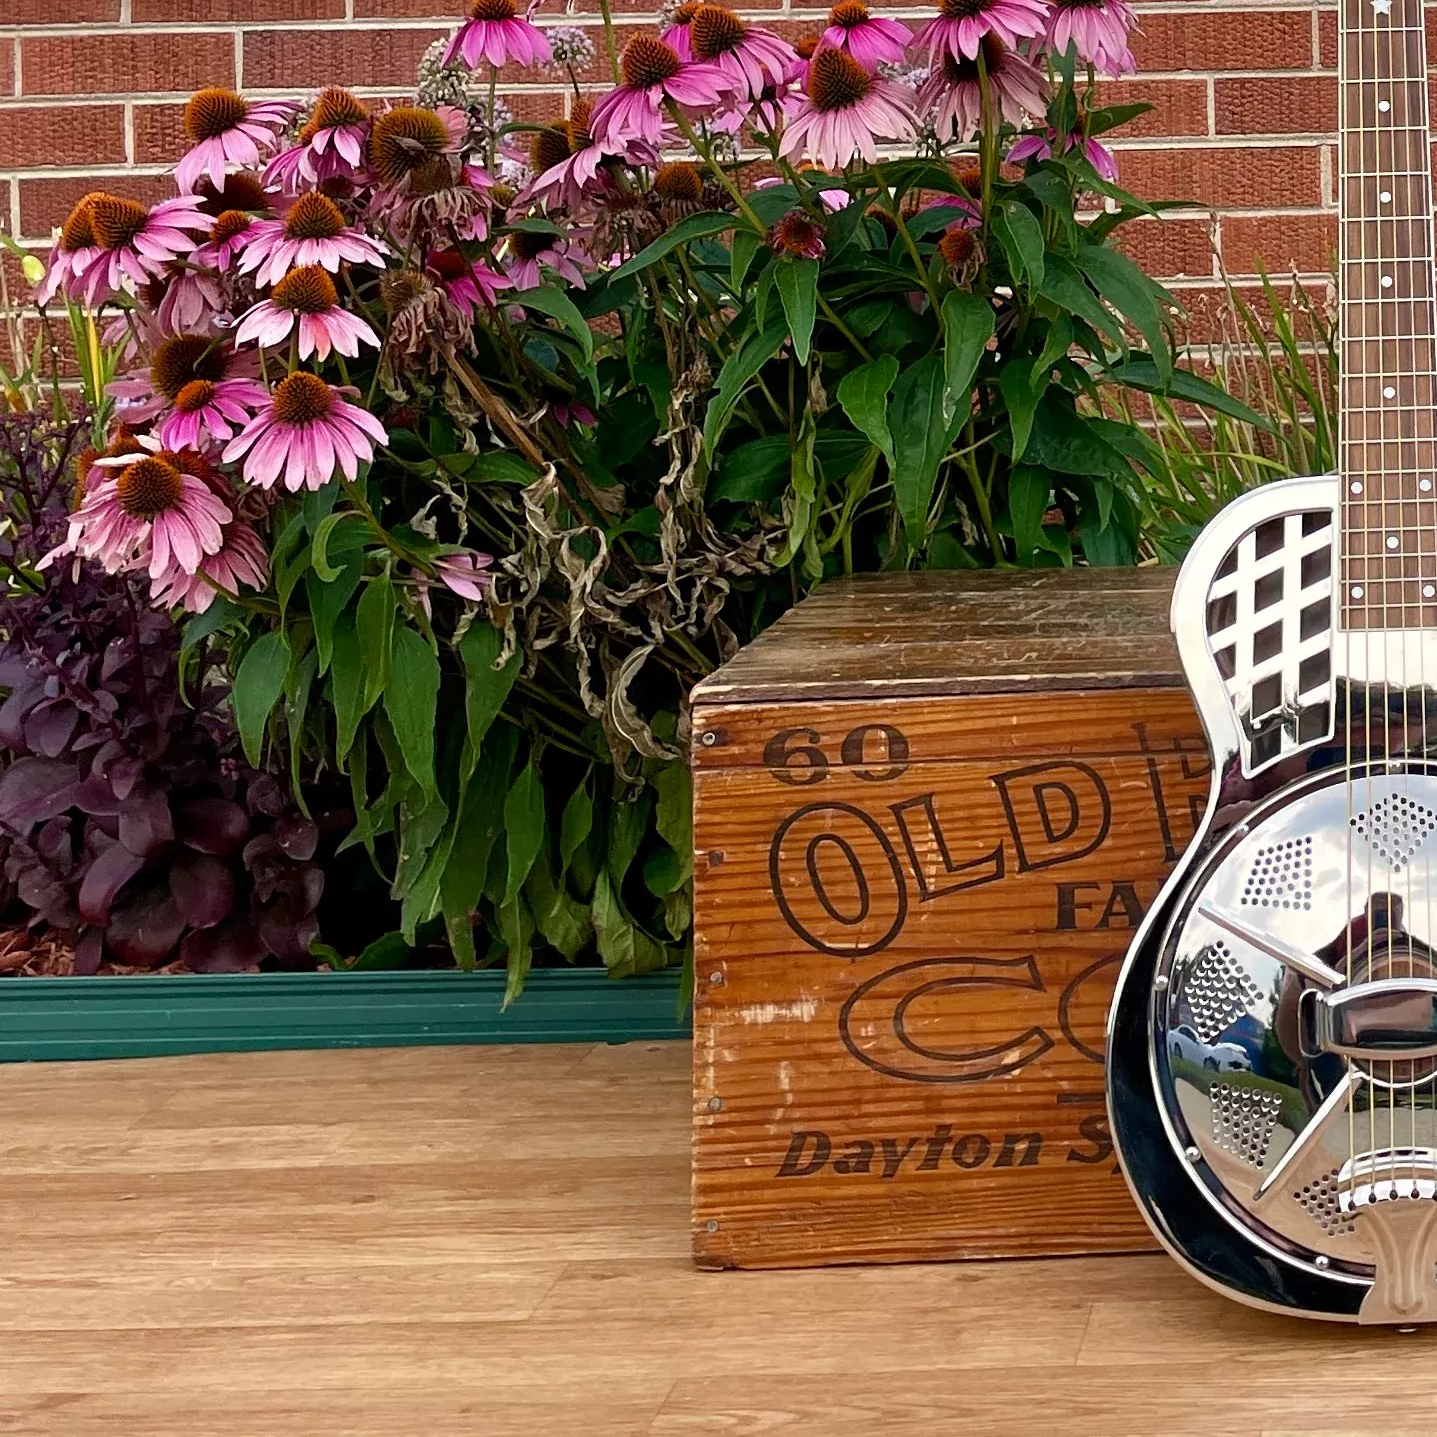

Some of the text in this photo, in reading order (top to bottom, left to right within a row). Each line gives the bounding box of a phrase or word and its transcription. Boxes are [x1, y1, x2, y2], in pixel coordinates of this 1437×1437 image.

[761, 723, 911, 786] 60
[769, 759, 1112, 957] OLD
[775, 1122, 1044, 1179] Dayton
